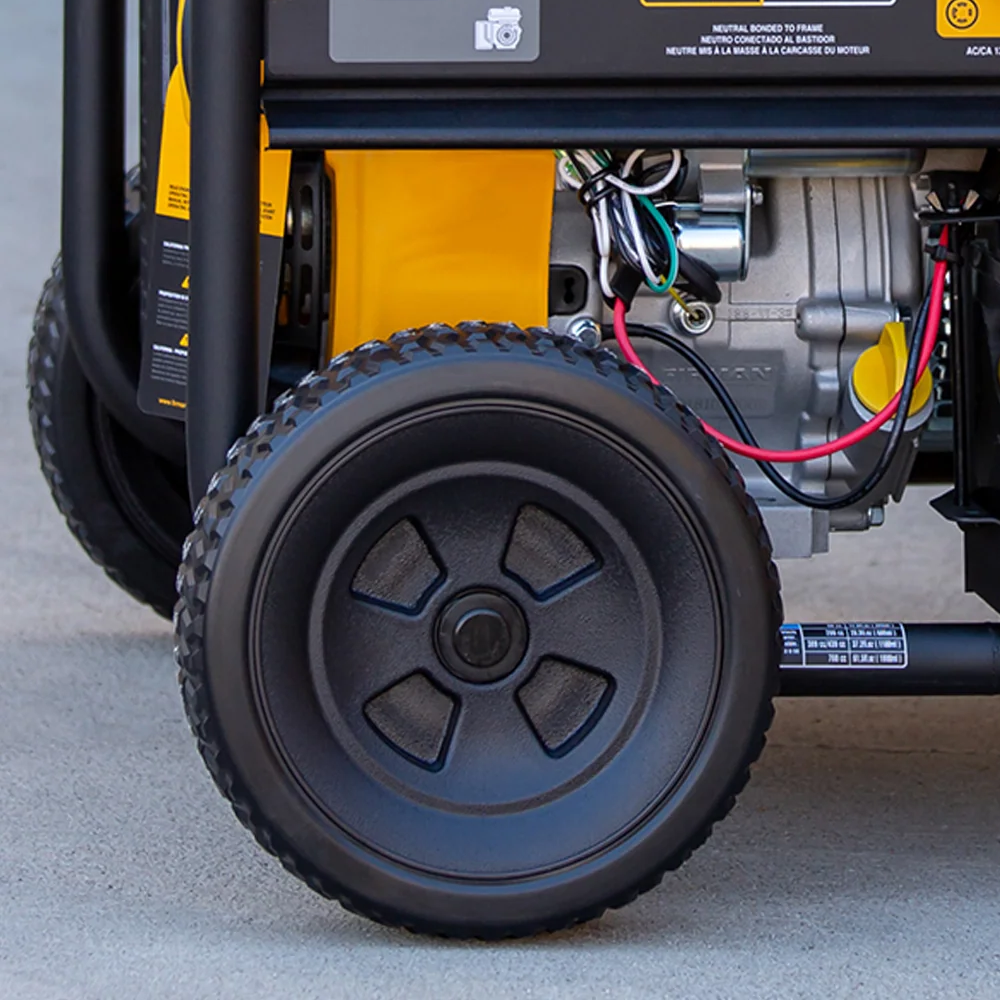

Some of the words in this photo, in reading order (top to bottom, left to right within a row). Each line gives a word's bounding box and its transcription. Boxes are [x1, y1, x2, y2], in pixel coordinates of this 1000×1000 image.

[712, 24, 749, 34] NEUTRAL
[750, 24, 783, 34] BONDED
[784, 24, 795, 34] TO
[796, 24, 824, 34] FRAME
[700, 35, 733, 44] NEUTRO
[784, 35, 794, 44] AL
[796, 35, 836, 44] BASTIDOR
[666, 46, 698, 56] NEUTRE
[698, 46, 713, 56] MIS
[721, 46, 732, 56] LA
[733, 46, 760, 56] MASSE
[768, 46, 780, 56] LA
[781, 46, 824, 56] CARCASSE
[824, 46, 836, 56] DU
[838, 46, 870, 55] MOTEUR
[966, 46, 993, 56] AC/CA
